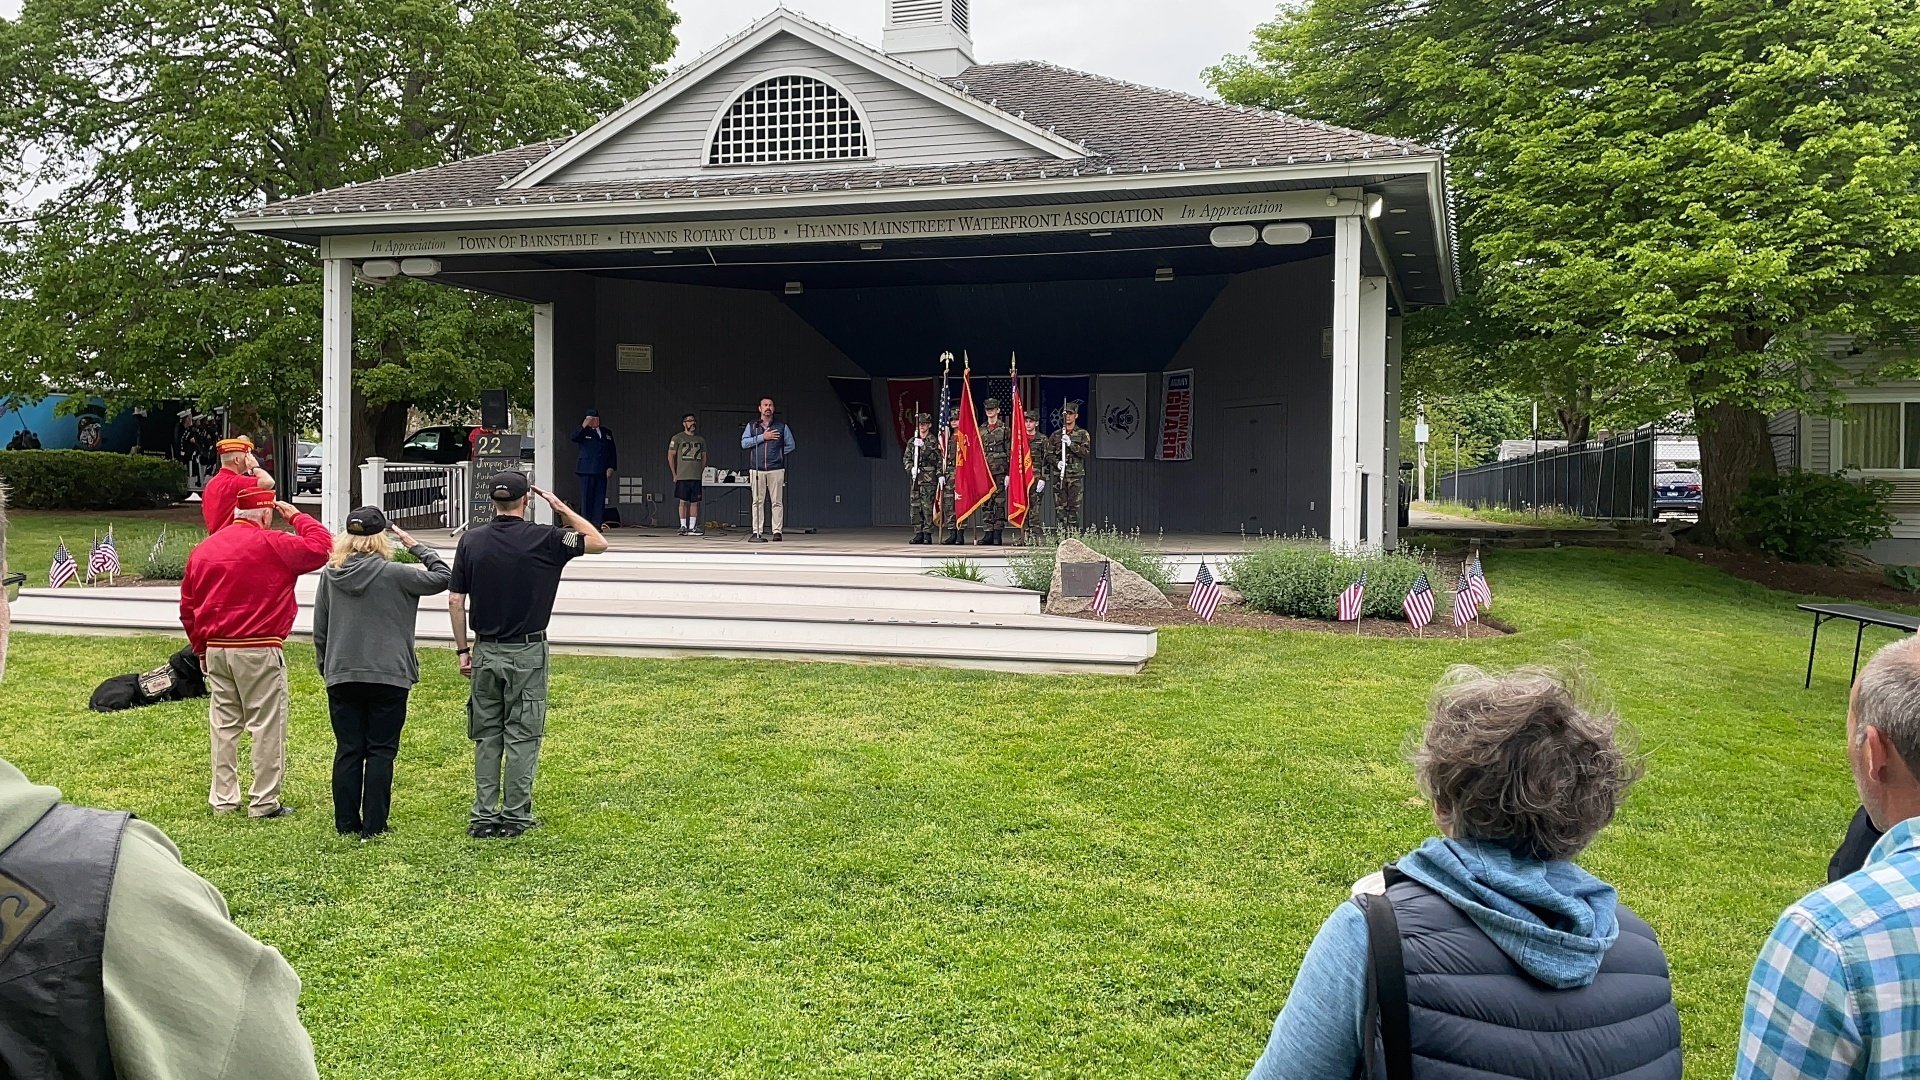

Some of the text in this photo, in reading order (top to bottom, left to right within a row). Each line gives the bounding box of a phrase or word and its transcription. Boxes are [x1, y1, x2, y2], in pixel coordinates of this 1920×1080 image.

[371, 200, 1283, 255] In Appreciation TOWN OF BARNSTABLE HYANNIS ROTARY CLUB HYANNIS MAINSTREET WATERFRONT ASSOCIATION In Appreciation
[1163, 391, 1182, 459] GUARD
[1177, 390, 1190, 444] NATIONAL
[478, 436, 502, 455] 22
[682, 442, 702, 461] 22
